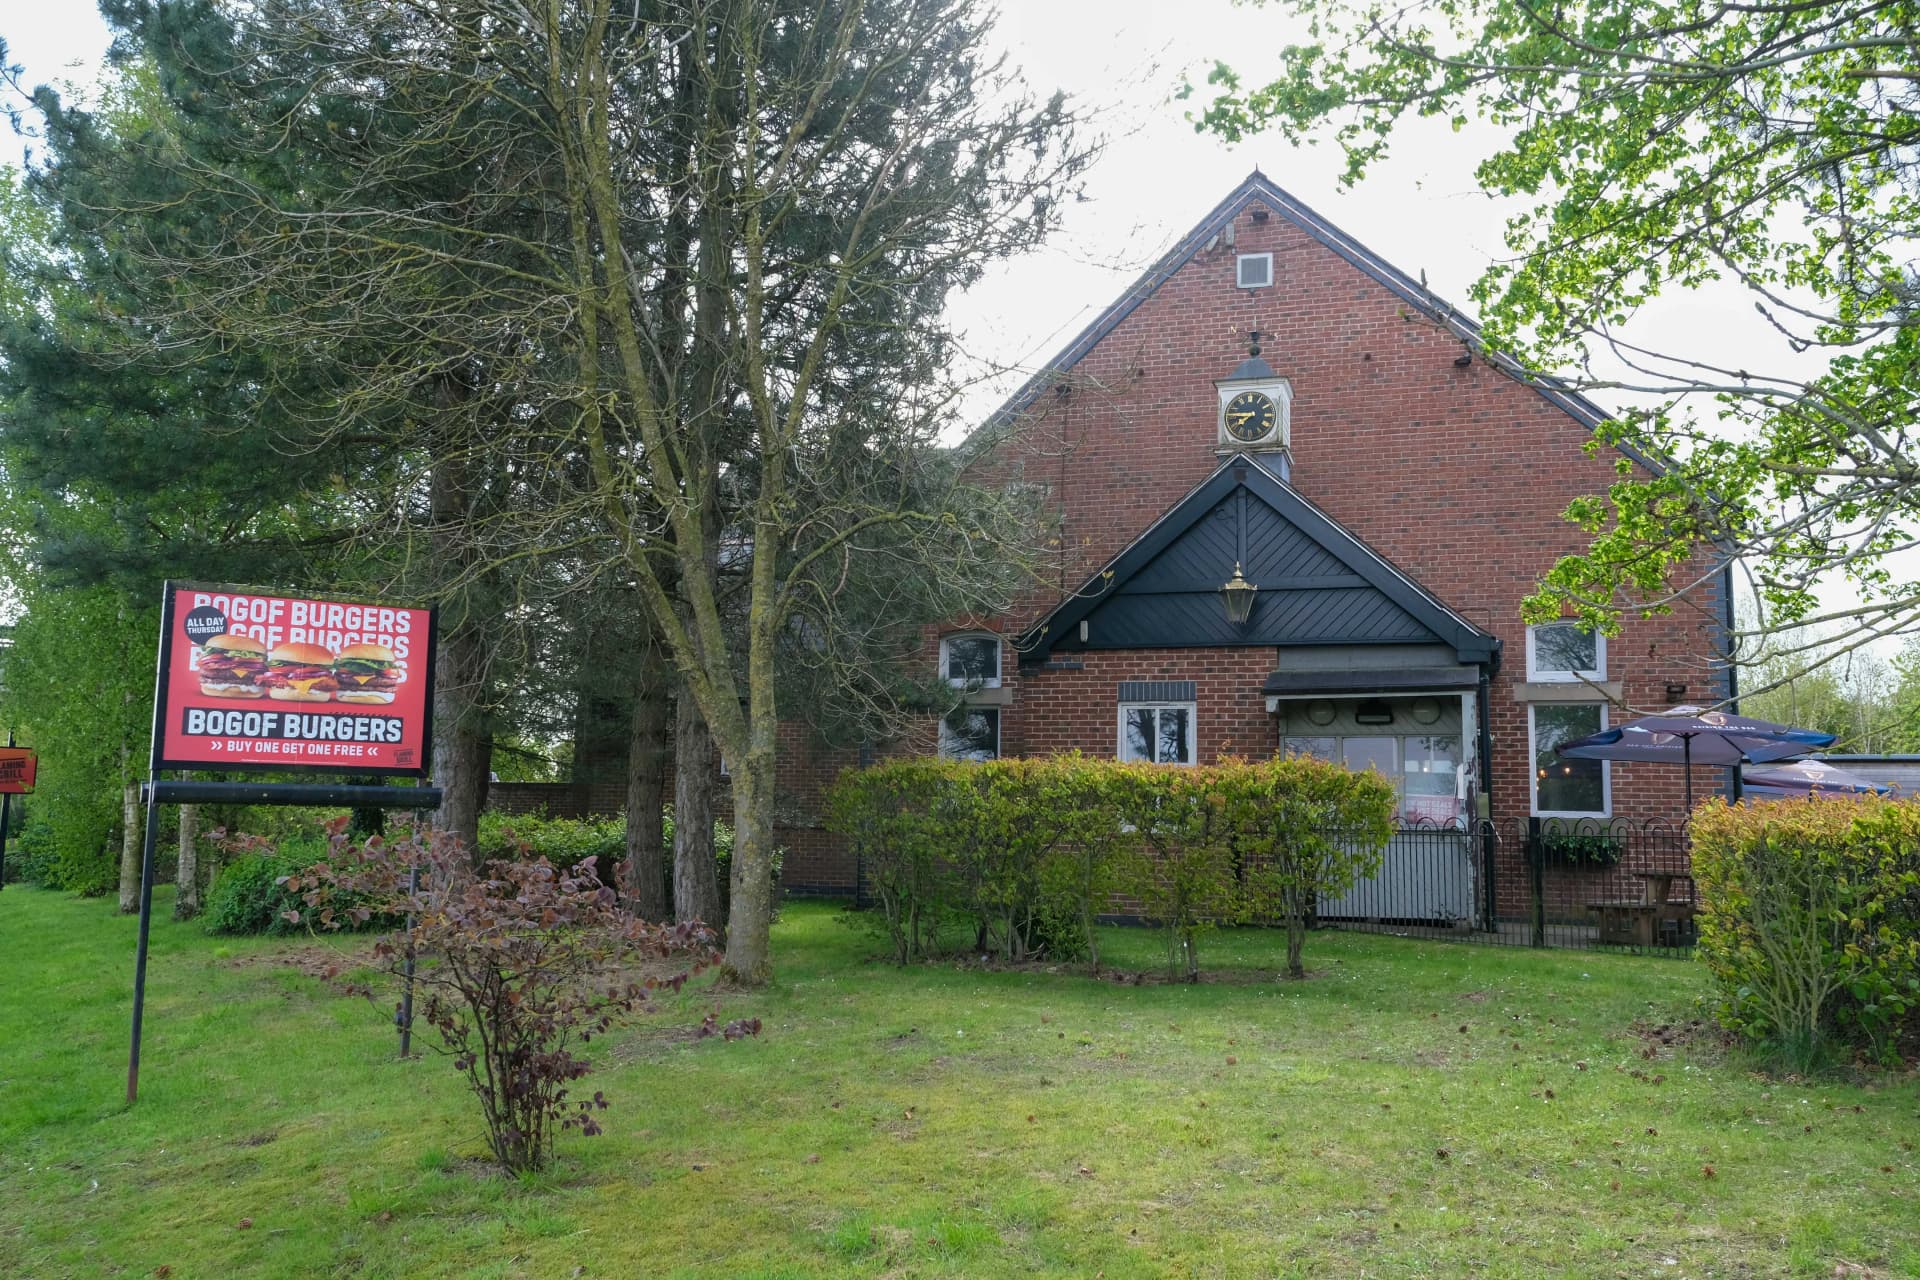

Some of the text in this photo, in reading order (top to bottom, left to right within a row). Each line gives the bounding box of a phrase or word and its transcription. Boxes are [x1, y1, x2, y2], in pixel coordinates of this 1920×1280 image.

[187, 617, 224, 627] ALL DAY
[291, 601, 411, 634] BURGERS
[187, 625, 224, 634] THURSDAY
[229, 623, 283, 650] GOF
[188, 709, 402, 742] BOGOF BURGERS
[227, 740, 363, 756] BUY ONE GET ONE FREE
